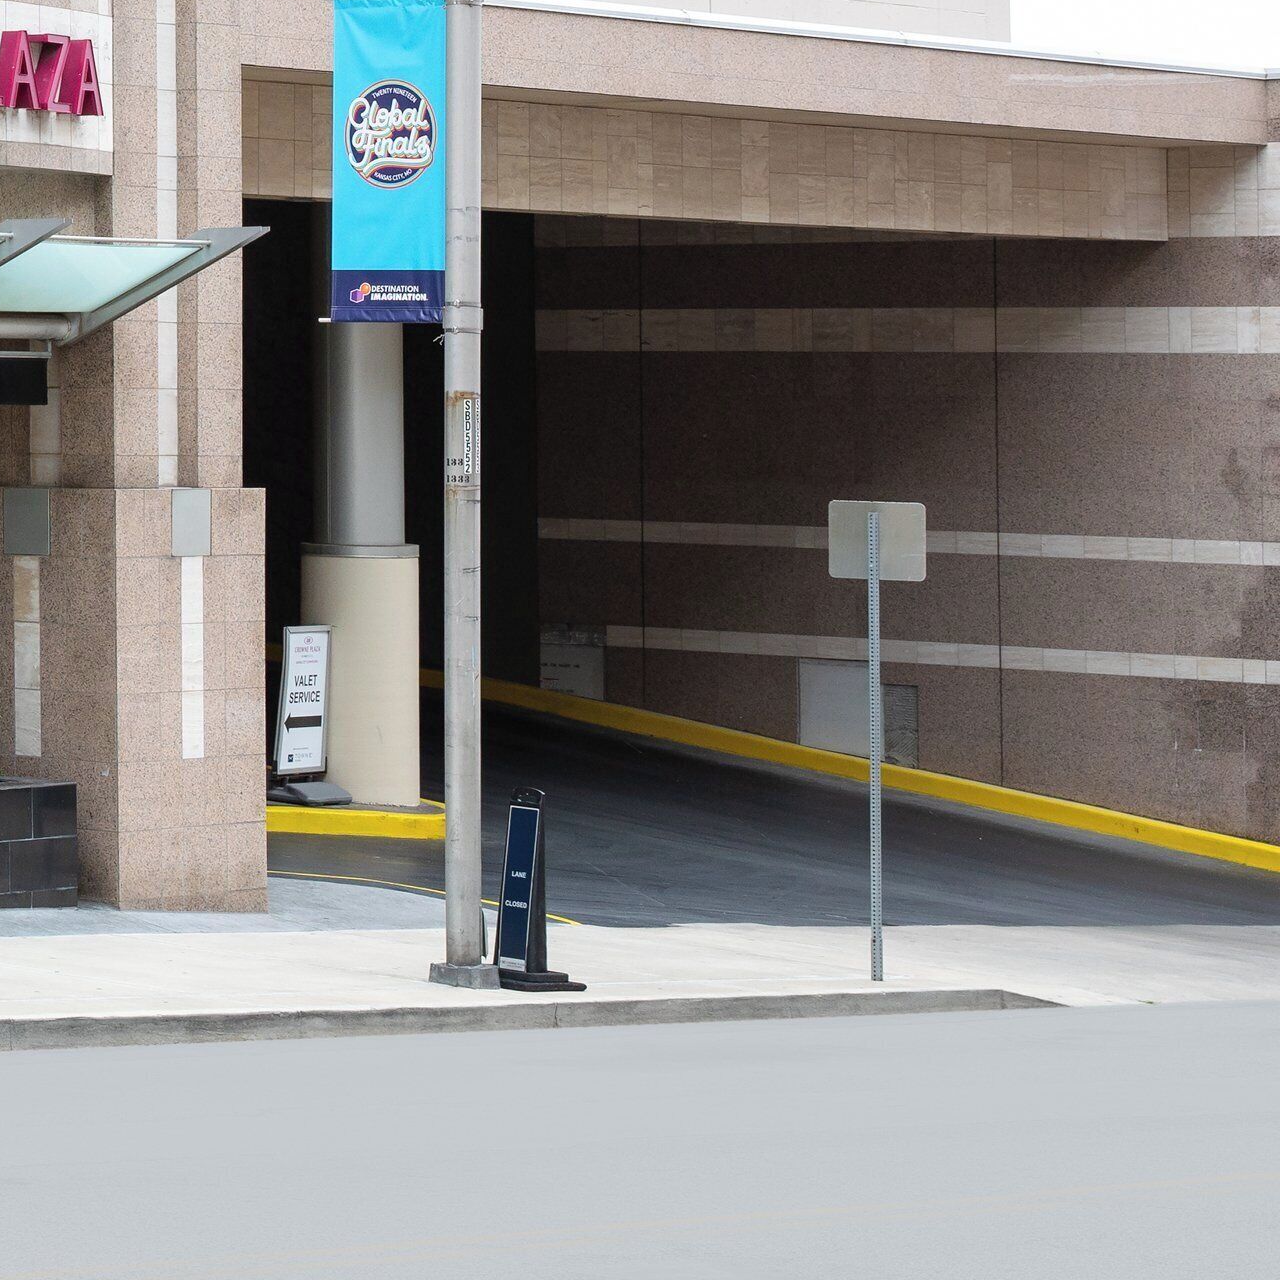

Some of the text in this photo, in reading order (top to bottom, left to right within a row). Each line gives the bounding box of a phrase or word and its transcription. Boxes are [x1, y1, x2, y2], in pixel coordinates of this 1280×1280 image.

[372, 87, 393, 99] TWENTY
[348, 97, 429, 131] Global
[349, 126, 432, 168] Finals
[374, 171, 392, 182] KANSAS
[403, 168, 413, 178] MO
[371, 285, 419, 293] DESTINATION
[464, 400, 472, 474] SBD5552
[294, 674, 318, 687] VALET
[288, 690, 321, 704] SERVICE
[511, 870, 527, 879] LANE
[504, 899, 528, 909] CLOSED
